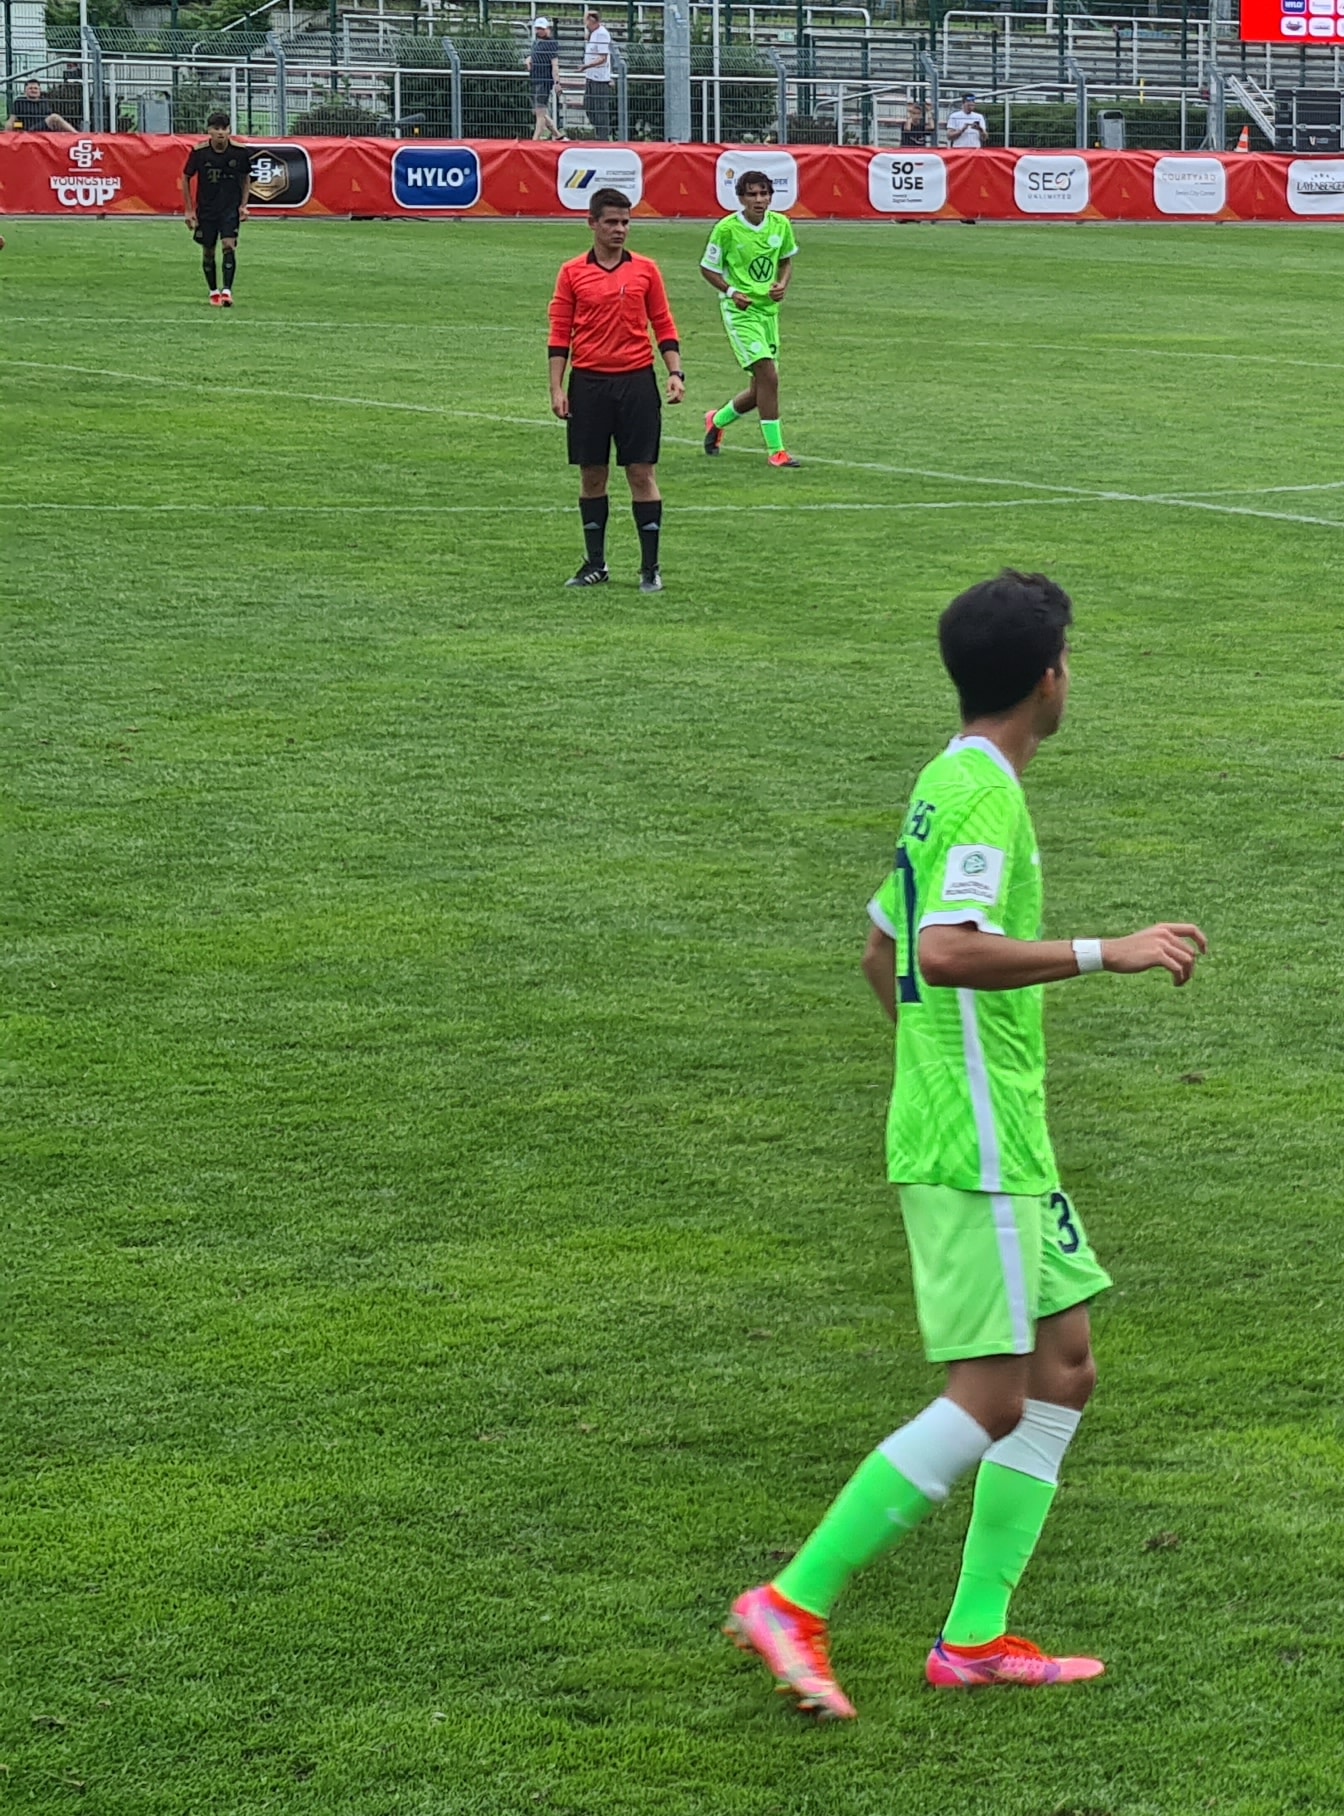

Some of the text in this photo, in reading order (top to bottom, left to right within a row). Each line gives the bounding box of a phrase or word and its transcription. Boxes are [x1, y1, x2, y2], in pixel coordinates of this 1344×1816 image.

[891, 161, 914, 175] SO
[53, 177, 118, 186] YOUNGSTER
[407, 167, 464, 187] HYLO
[892, 176, 924, 190] USE
[1028, 172, 1071, 191] SEO
[1162, 173, 1216, 181] COURTYARD
[58, 187, 114, 206] CUP
[1050, 1192, 1079, 1254] 3
